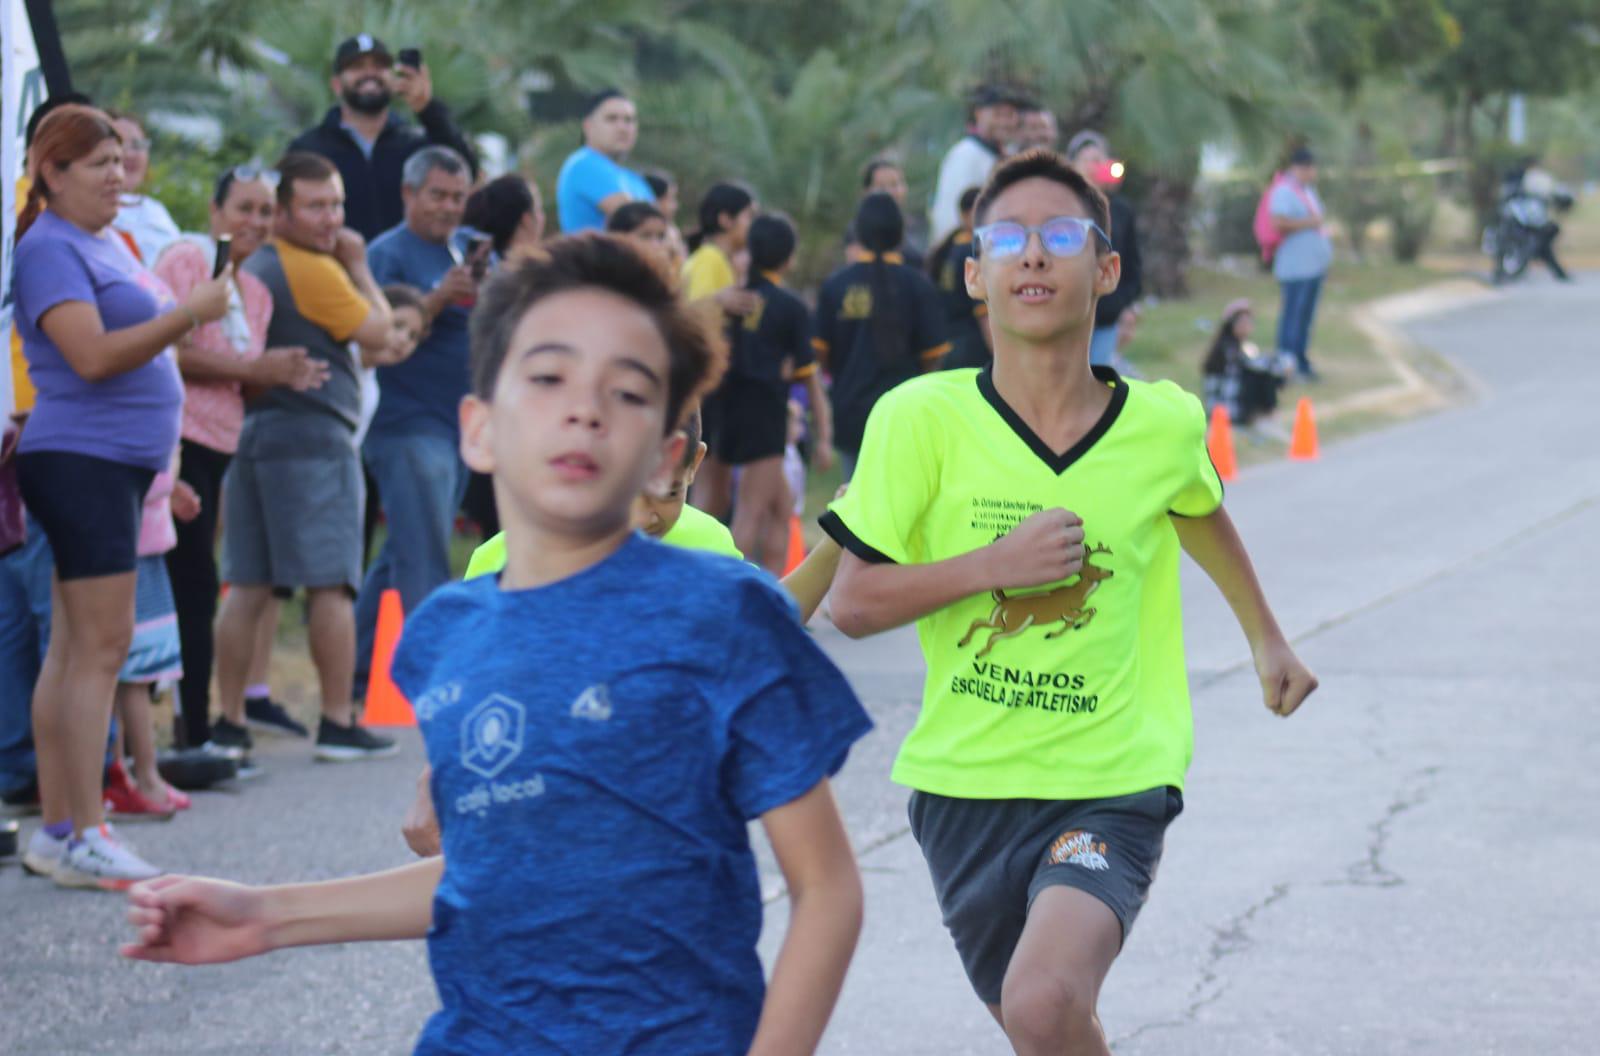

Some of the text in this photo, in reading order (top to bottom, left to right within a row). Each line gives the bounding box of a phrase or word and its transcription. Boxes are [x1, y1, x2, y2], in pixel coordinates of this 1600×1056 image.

[973, 662, 1085, 690] VENADOS
[951, 676, 1006, 705] ESCUELA
[1025, 690, 1098, 713] ATLETISMO
[491, 772, 545, 803] local
